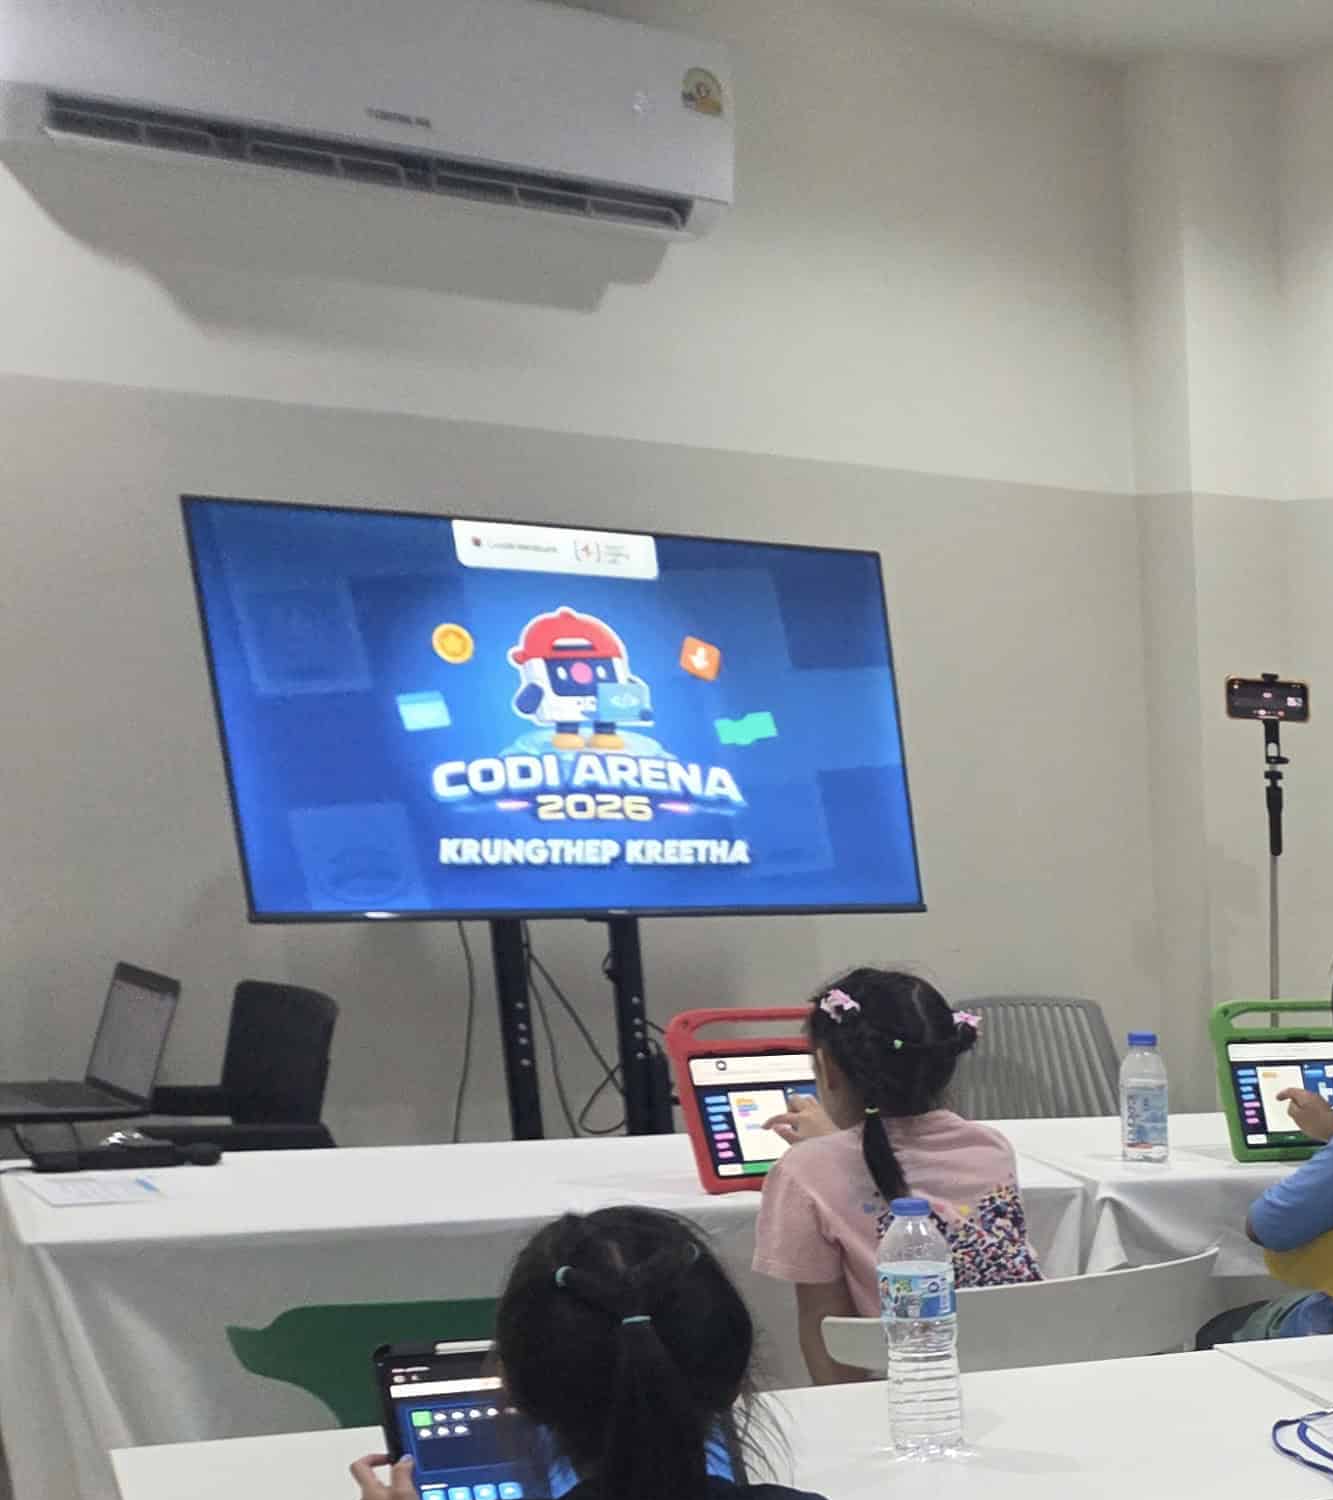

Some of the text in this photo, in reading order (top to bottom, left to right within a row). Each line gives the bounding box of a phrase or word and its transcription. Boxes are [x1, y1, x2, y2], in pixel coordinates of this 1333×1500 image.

[432, 755, 745, 803] CODI ARENA
[536, 794, 654, 821] 2026
[438, 837, 752, 866] KRUNGTHEP KREETHA
